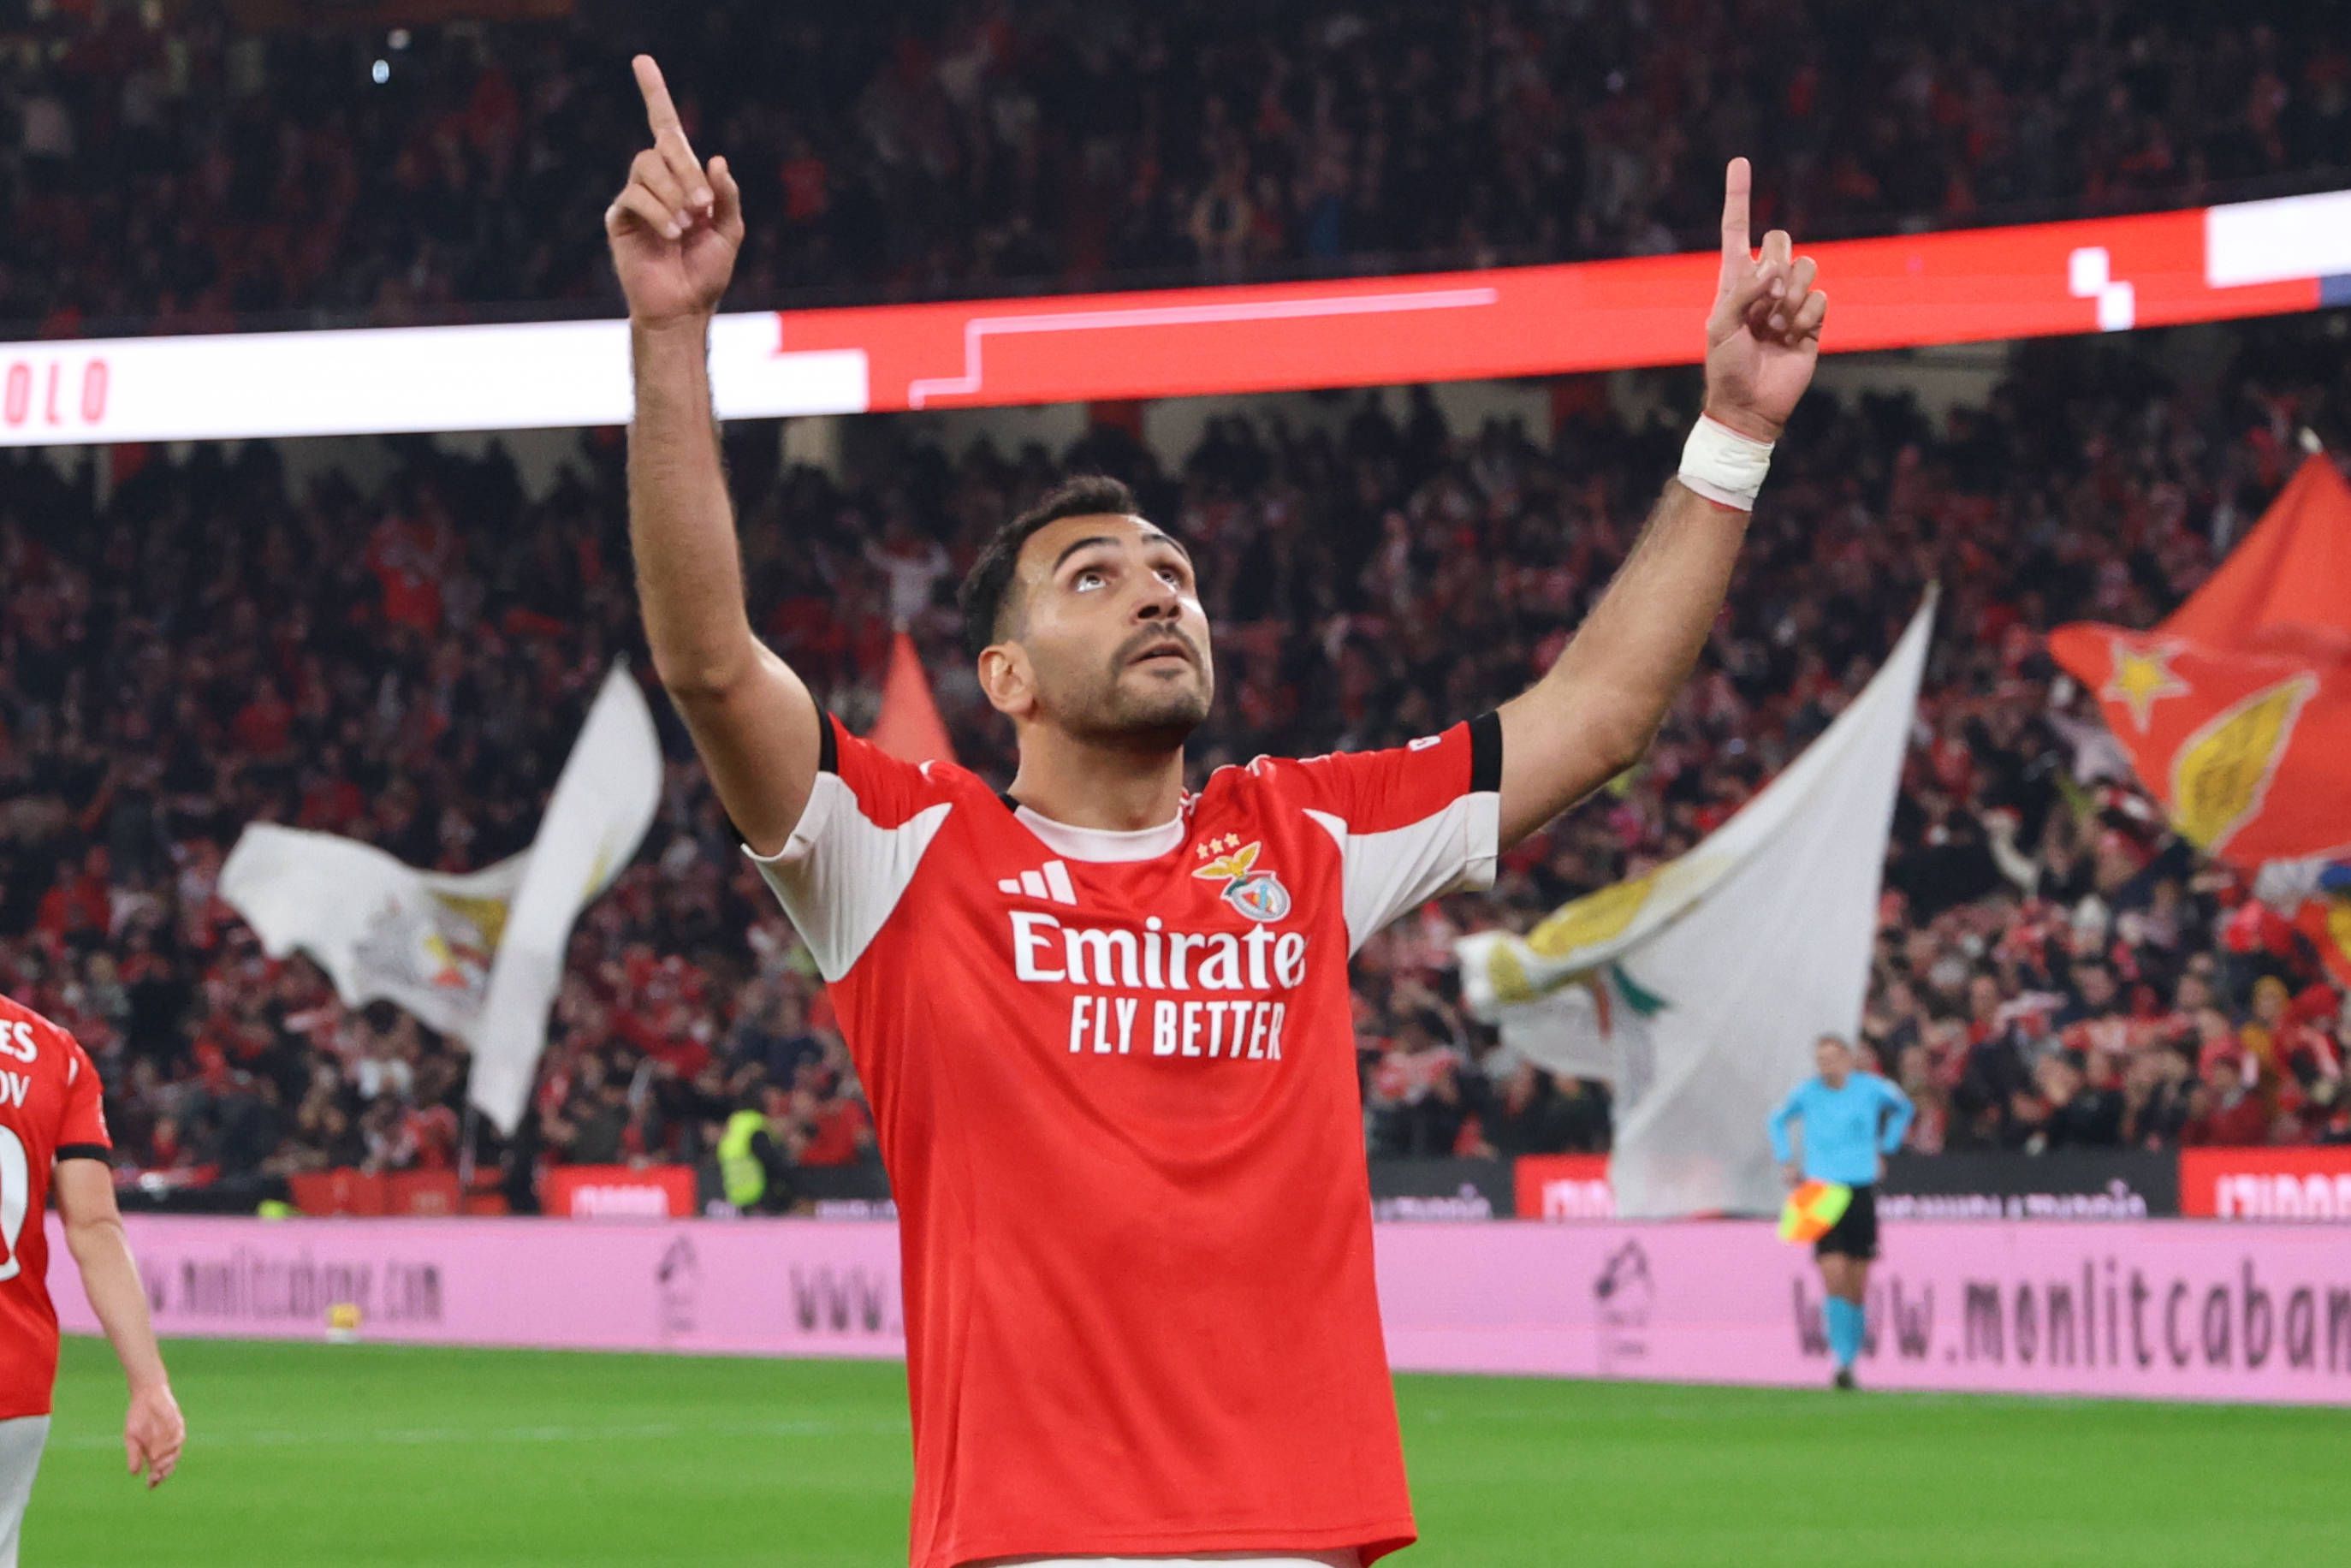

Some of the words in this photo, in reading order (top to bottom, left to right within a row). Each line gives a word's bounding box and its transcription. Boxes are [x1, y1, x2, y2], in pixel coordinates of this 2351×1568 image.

[1009, 910, 1310, 990] Emirate
[1069, 995, 1137, 1054] FLY
[1153, 1000, 1285, 1060] BETTER
